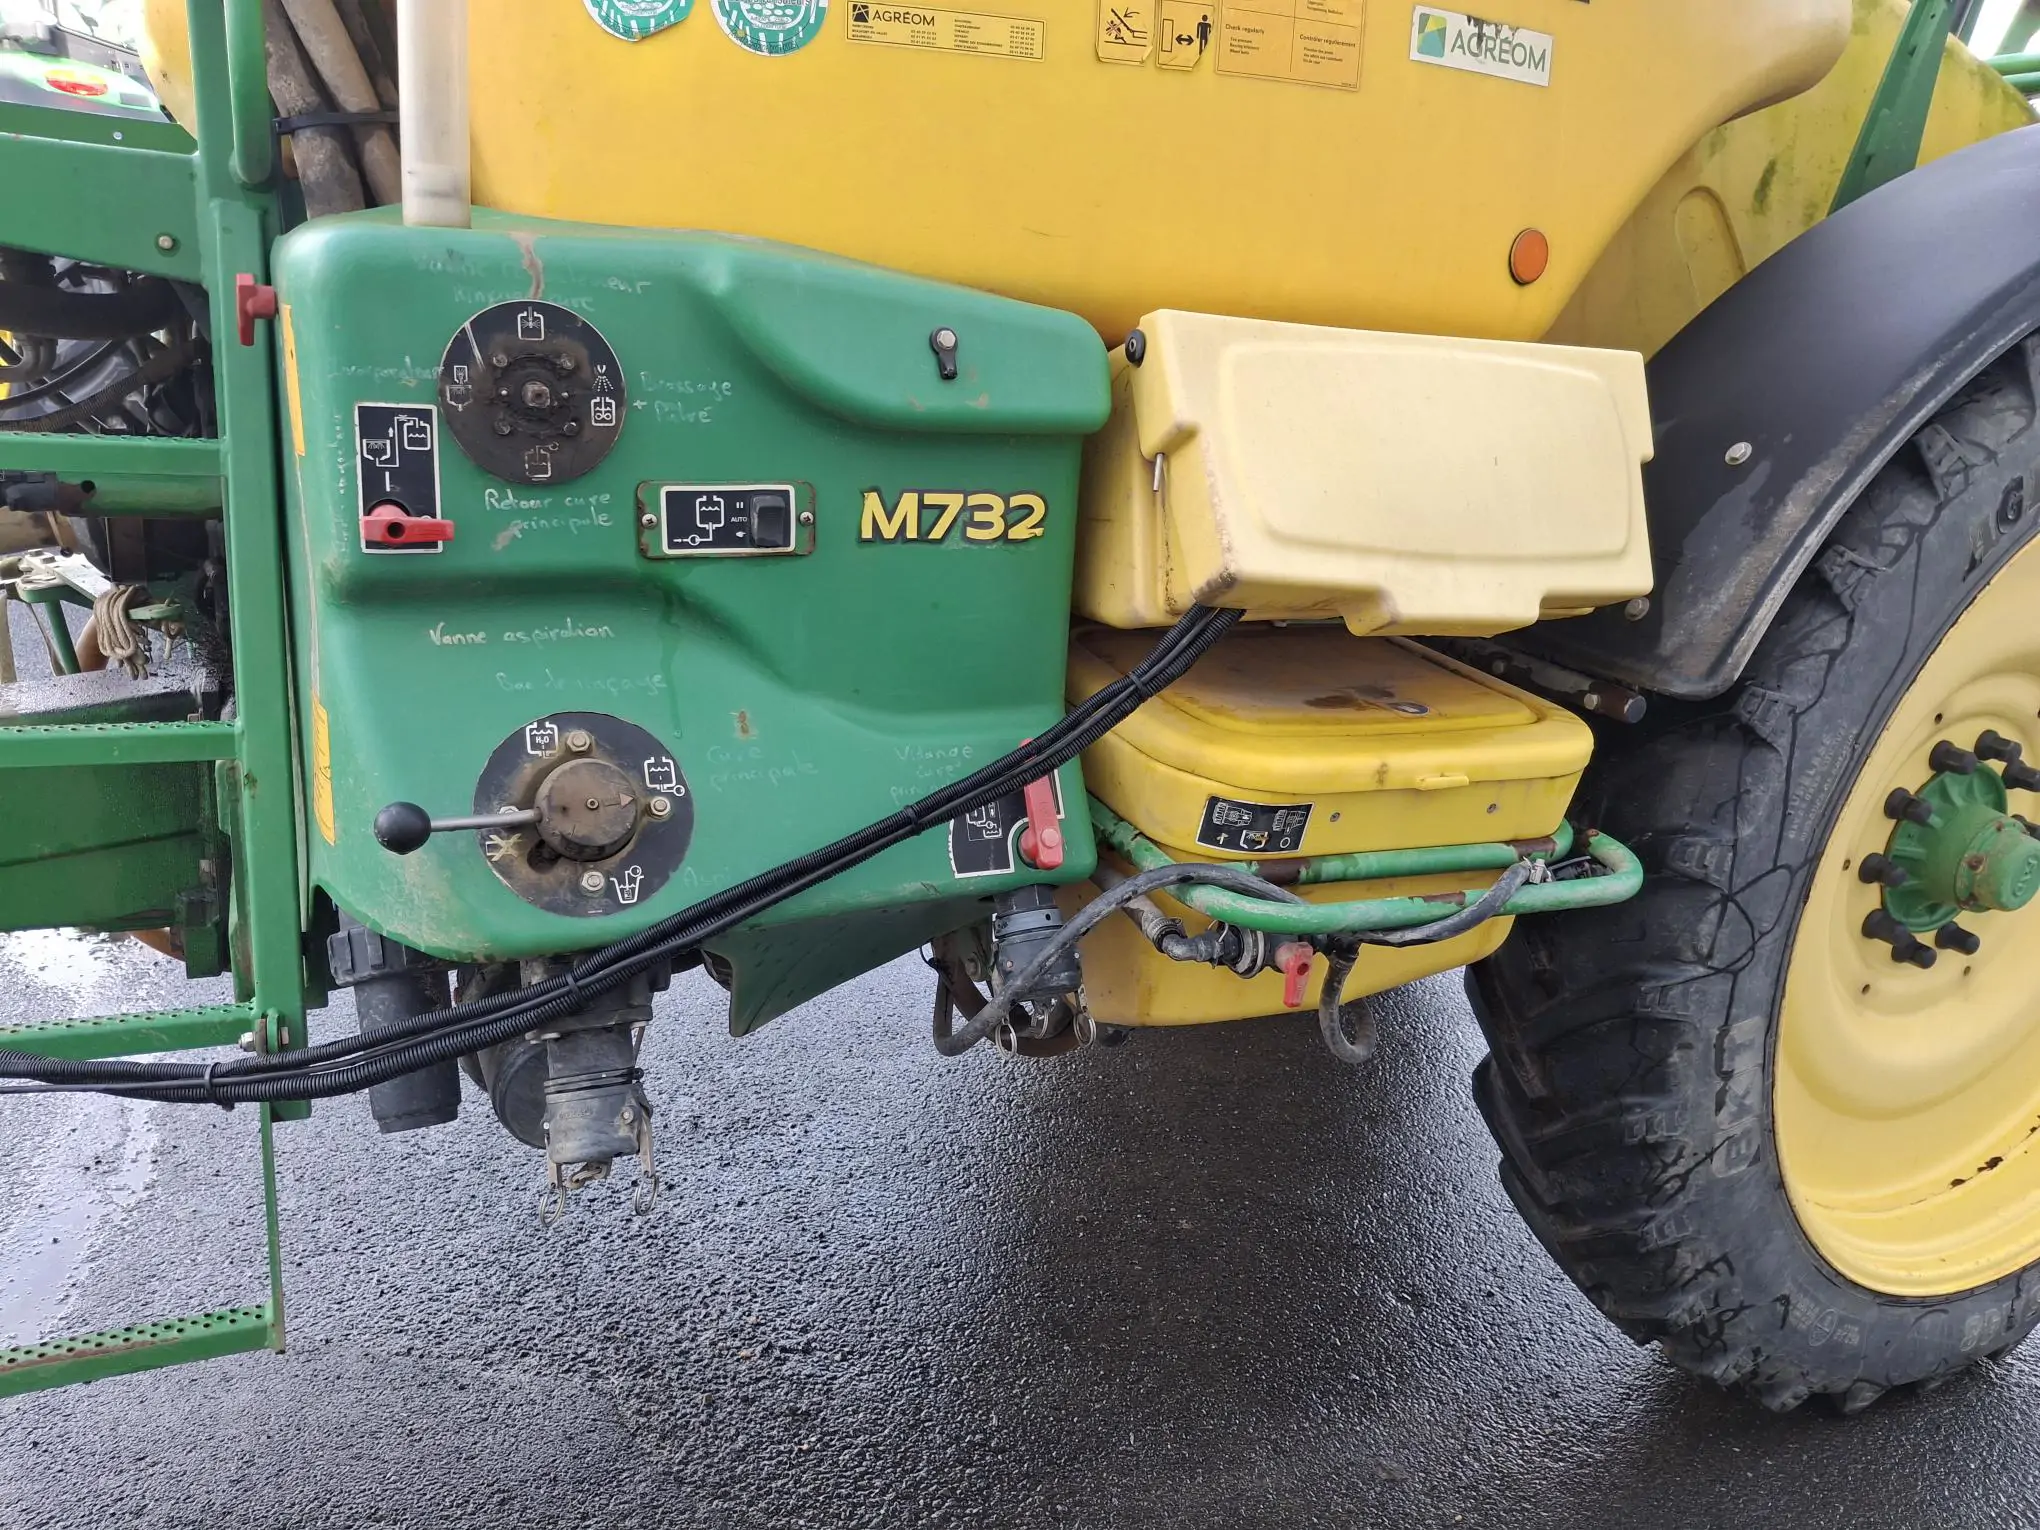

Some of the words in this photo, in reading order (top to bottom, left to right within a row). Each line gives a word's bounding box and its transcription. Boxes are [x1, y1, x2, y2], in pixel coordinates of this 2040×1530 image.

[872, 9, 935, 27] AGRÉOM
[1450, 28, 1547, 73] AGRÉOM
[859, 489, 1048, 543] M732
[428, 620, 487, 646] Vanne
[1711, 1014, 1766, 1179] BKT
